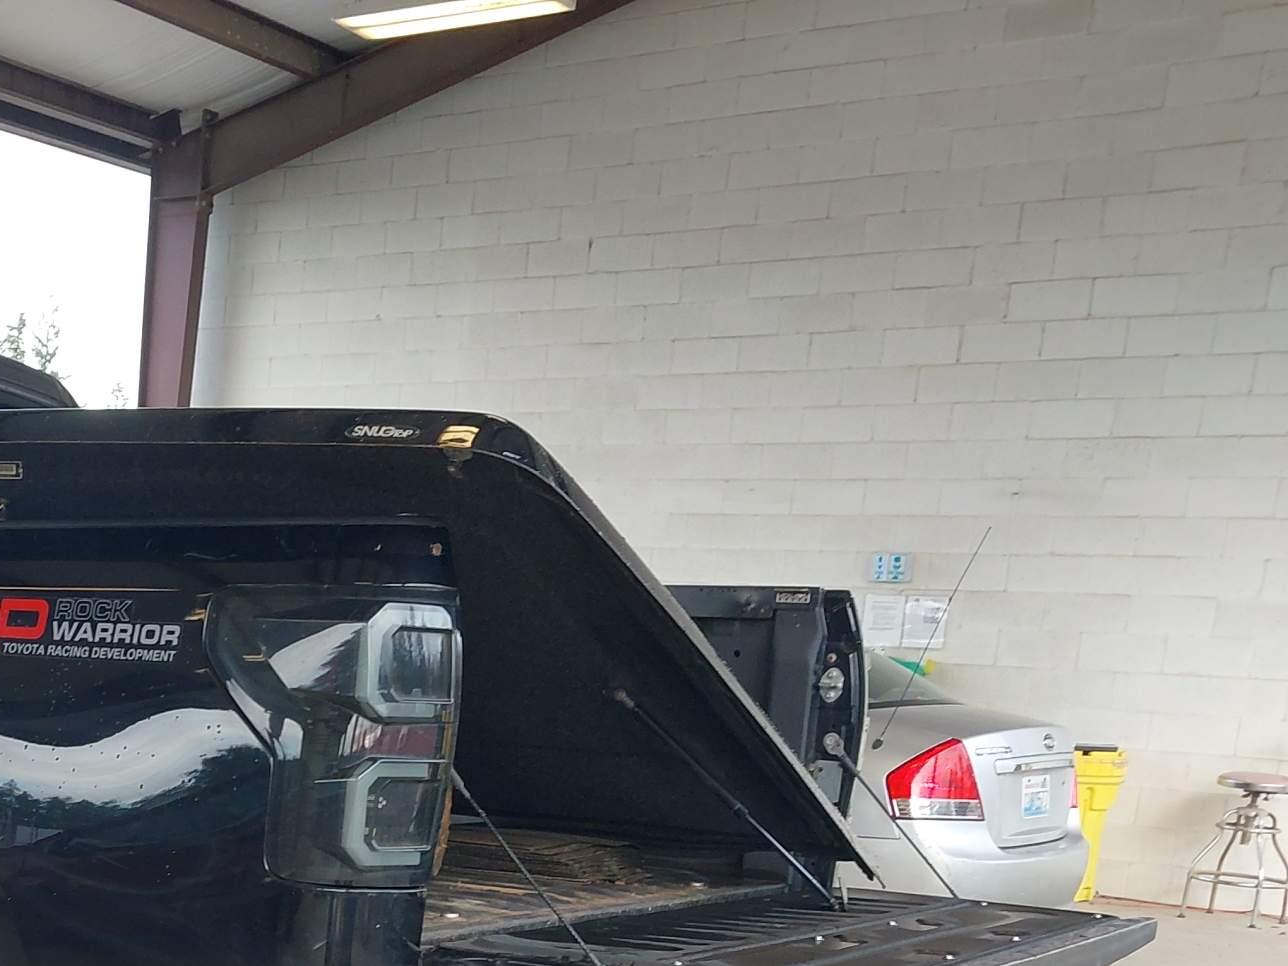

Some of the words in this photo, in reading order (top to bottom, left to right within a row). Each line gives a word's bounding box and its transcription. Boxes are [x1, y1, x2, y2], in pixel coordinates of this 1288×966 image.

[54, 598, 133, 621] ROCK
[52, 620, 181, 646] WARRIOR
[2, 642, 45, 656] TOYOTA
[47, 645, 90, 659] RACING
[91, 647, 176, 662] DEVELOPMENT
